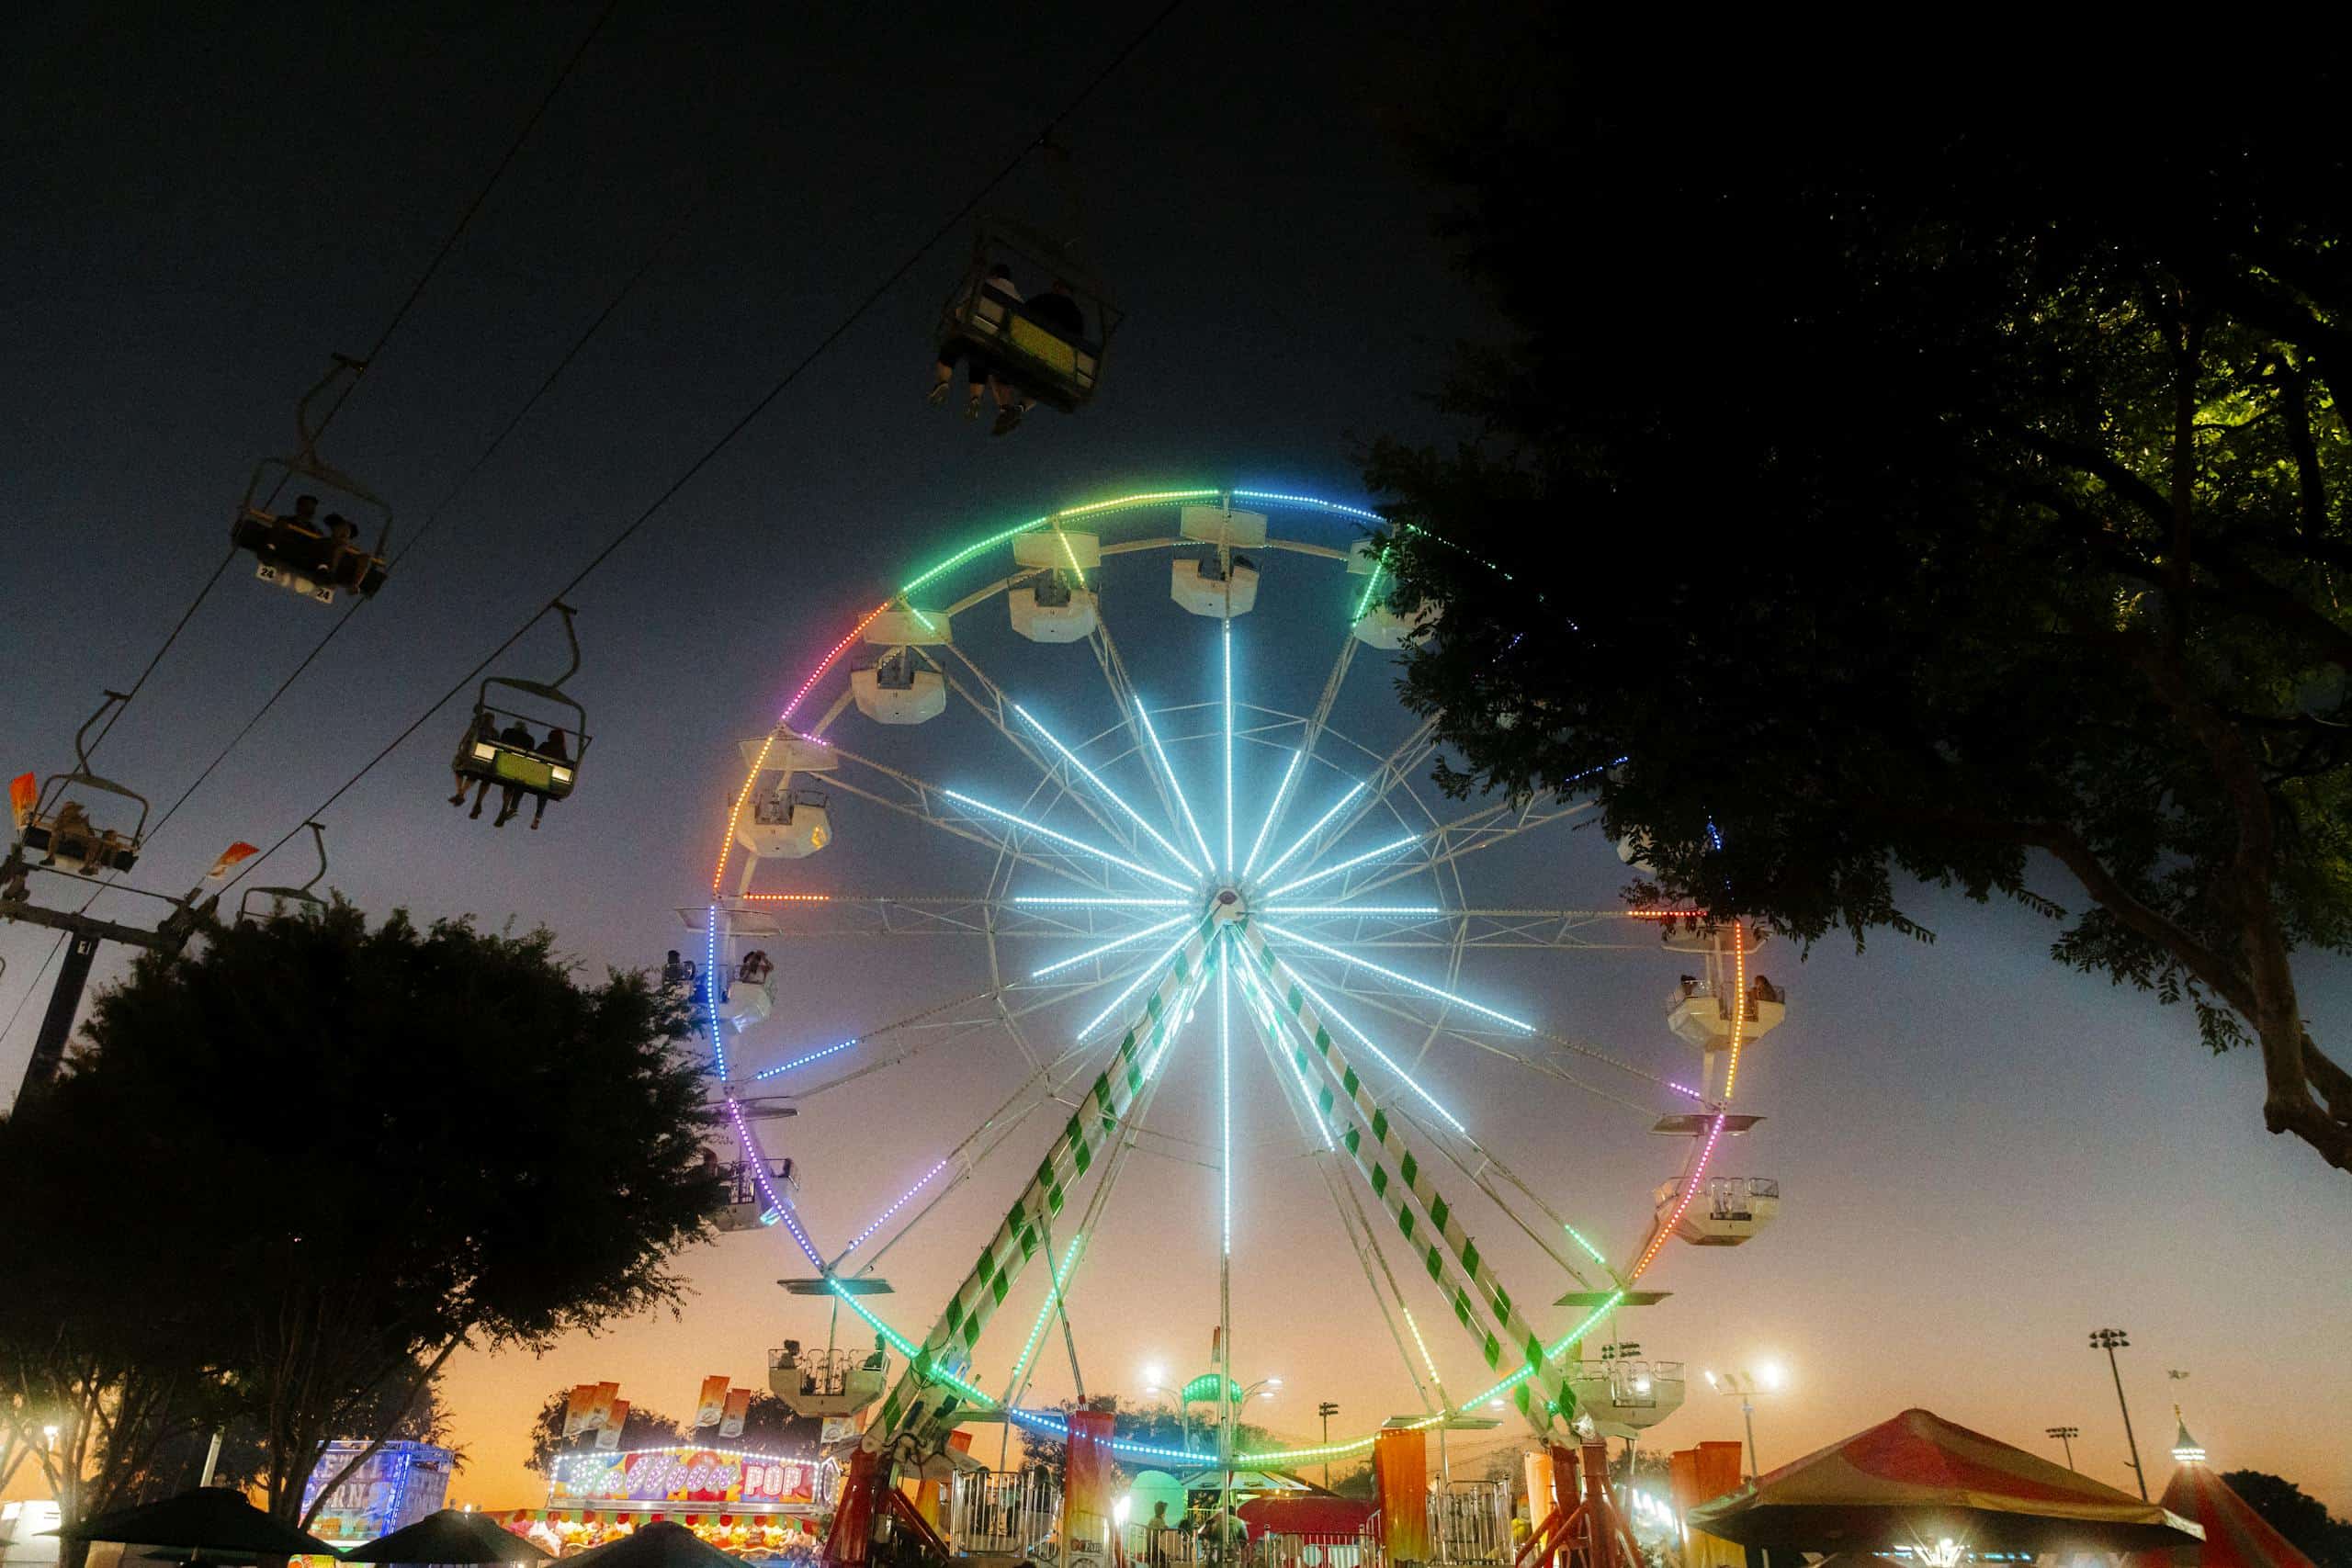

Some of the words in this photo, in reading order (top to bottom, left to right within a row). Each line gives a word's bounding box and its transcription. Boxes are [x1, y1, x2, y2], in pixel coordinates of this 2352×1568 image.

[260, 567, 275, 579] 24
[316, 589, 331, 600] 24
[566, 1454, 738, 1495] Balloon
[744, 1465, 802, 1495] POP
